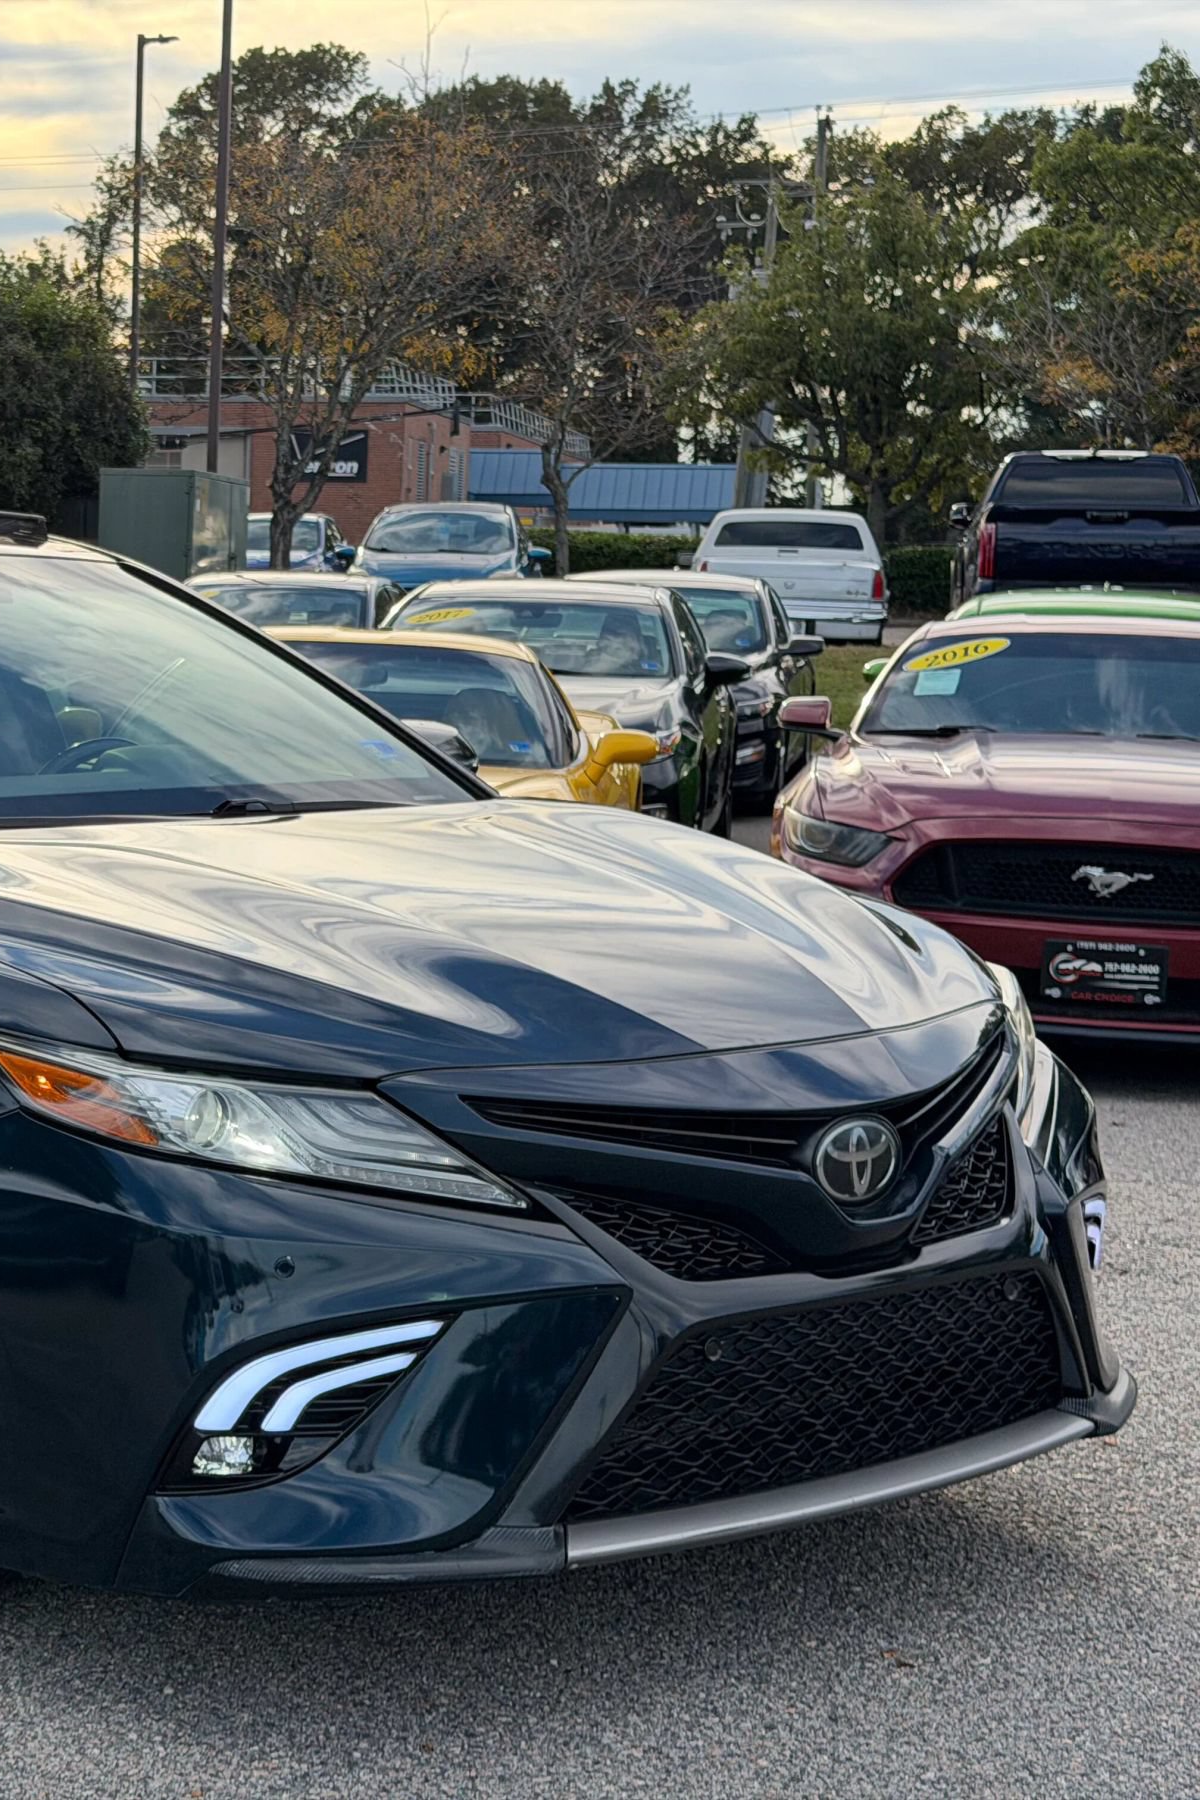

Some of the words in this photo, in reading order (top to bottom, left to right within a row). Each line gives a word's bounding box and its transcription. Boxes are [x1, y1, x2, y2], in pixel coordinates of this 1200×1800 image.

[292, 460, 359, 476] eron
[1042, 543, 1168, 560] TUNDRA
[415, 609, 464, 623] 2017
[924, 643, 989, 668] 2016
